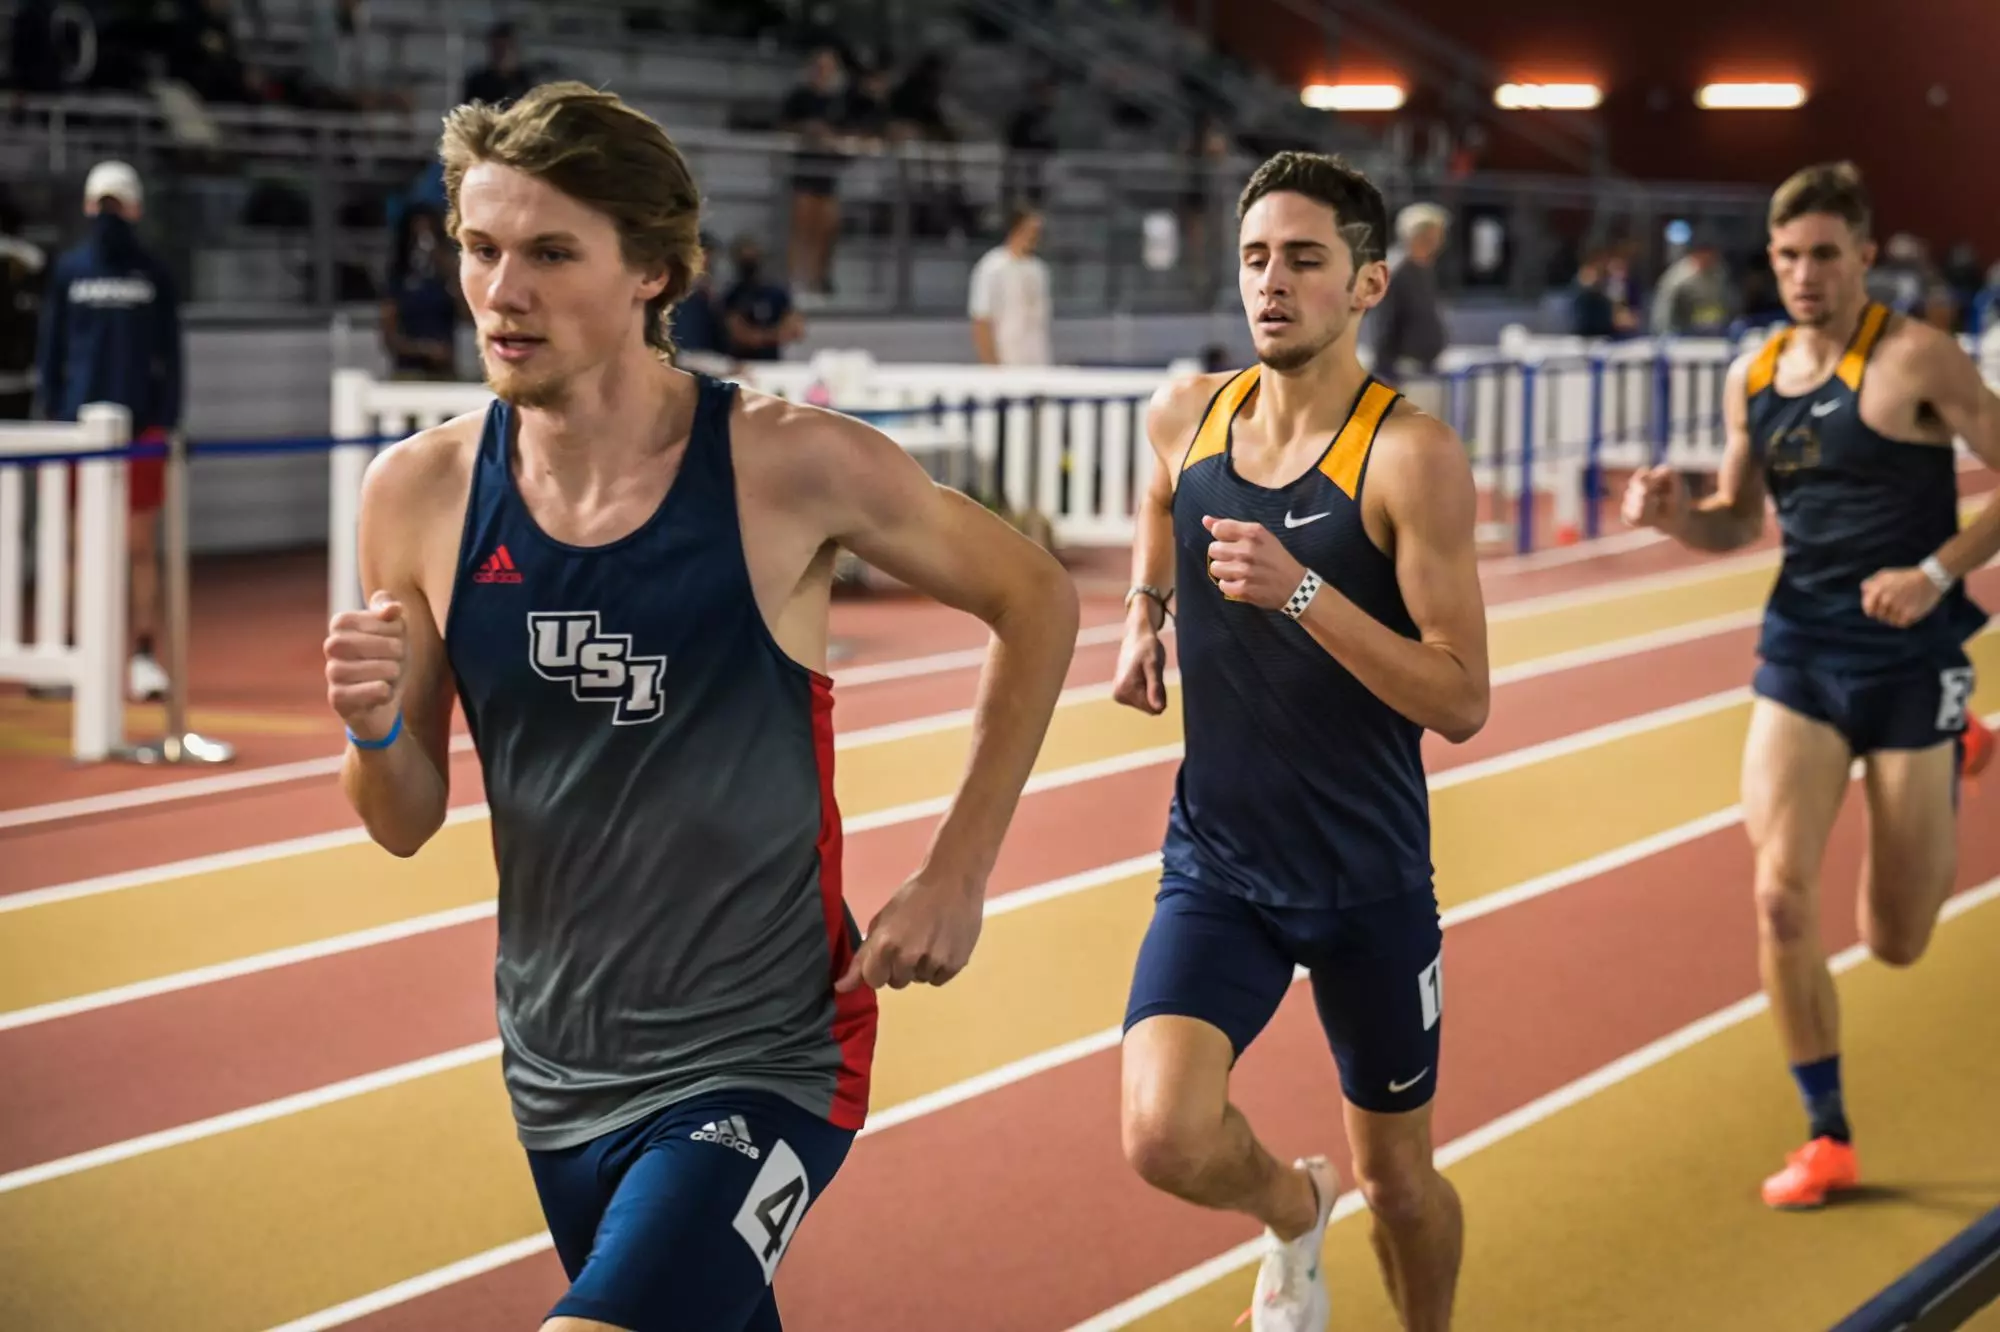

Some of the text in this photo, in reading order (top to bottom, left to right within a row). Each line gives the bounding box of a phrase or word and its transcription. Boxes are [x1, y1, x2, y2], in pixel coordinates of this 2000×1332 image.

[528, 611, 666, 724] USI
[1428, 964, 1440, 1014] 1
[690, 1130, 760, 1160] adidas
[754, 1174, 804, 1263] 4
